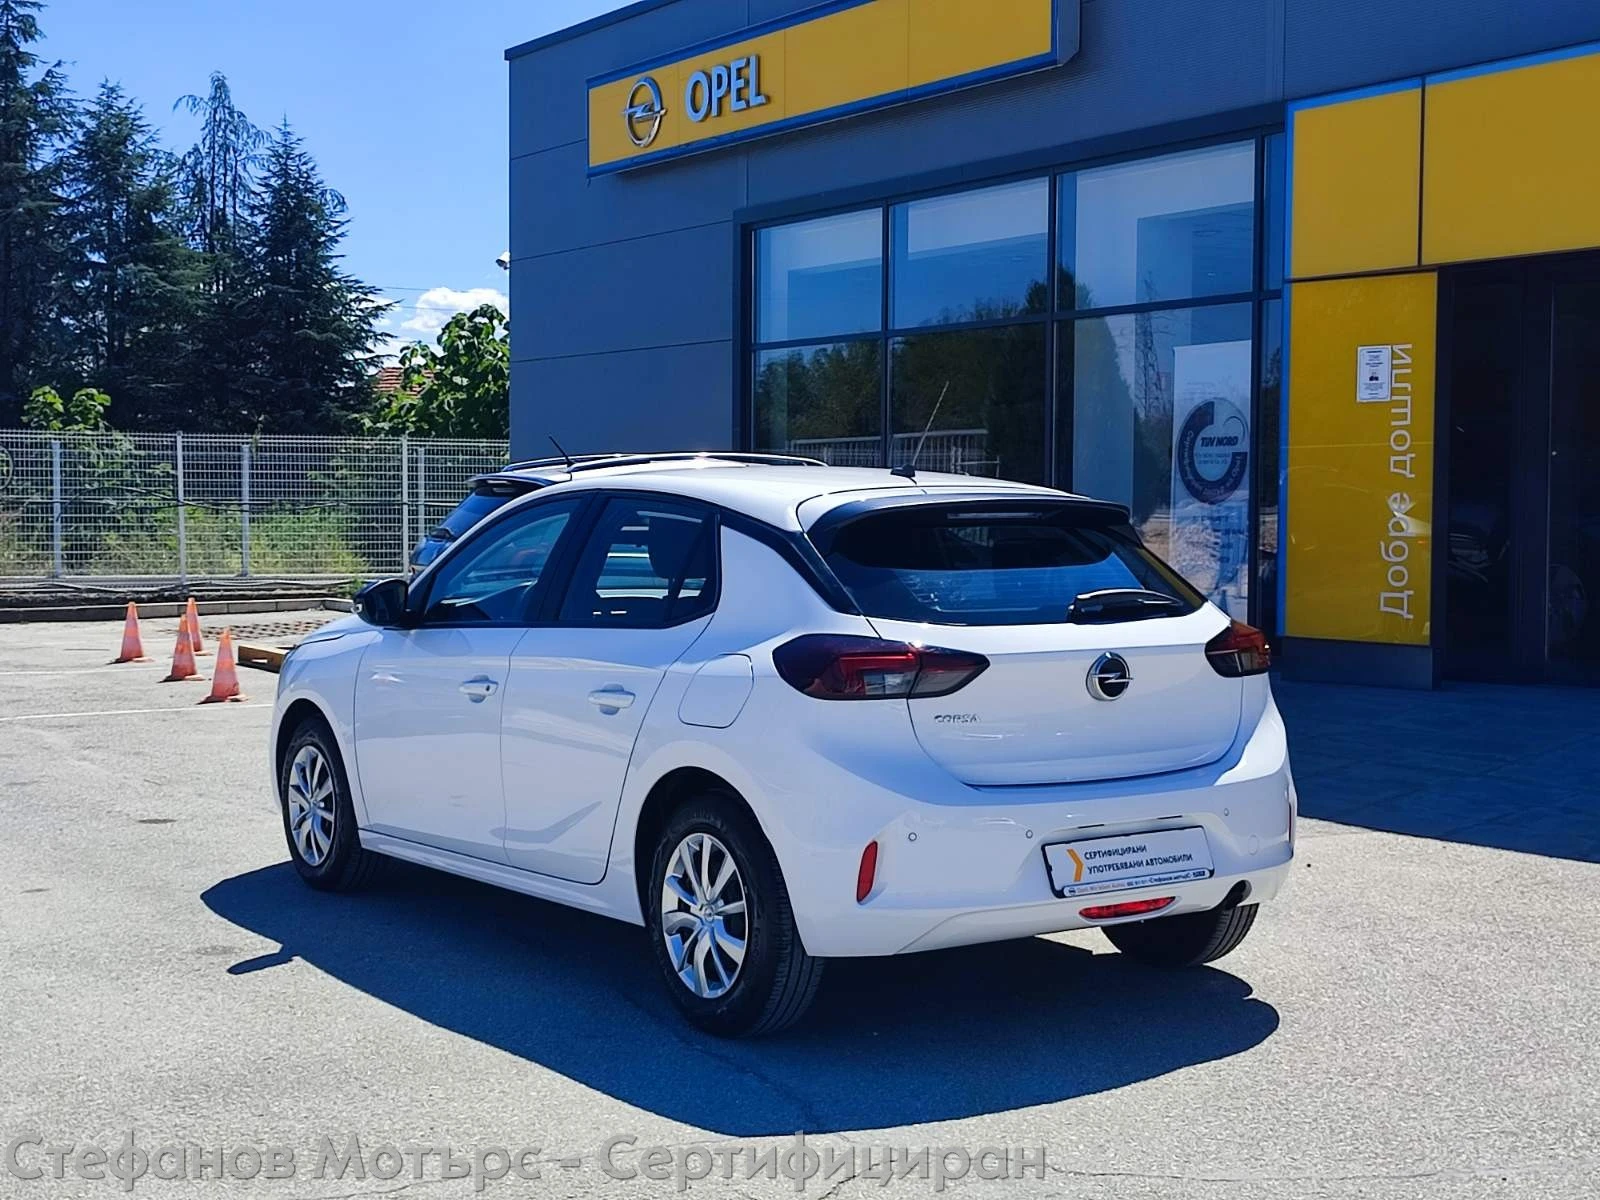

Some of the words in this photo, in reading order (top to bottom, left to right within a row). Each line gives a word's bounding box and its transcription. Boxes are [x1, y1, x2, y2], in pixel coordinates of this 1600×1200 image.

[685, 54, 768, 122] OPEL
[1389, 343, 1416, 478] дошли
[1215, 435, 1239, 447] NORD
[1380, 492, 1415, 619] Добре
[934, 714, 980, 723] CORSA
[1084, 844, 1147, 860] СЕРТИФИЦИРАНИ
[1088, 860, 1145, 874] УПОТРЕБЯВАНИ
[1145, 853, 1193, 867] АВТОМОБИЛИ
